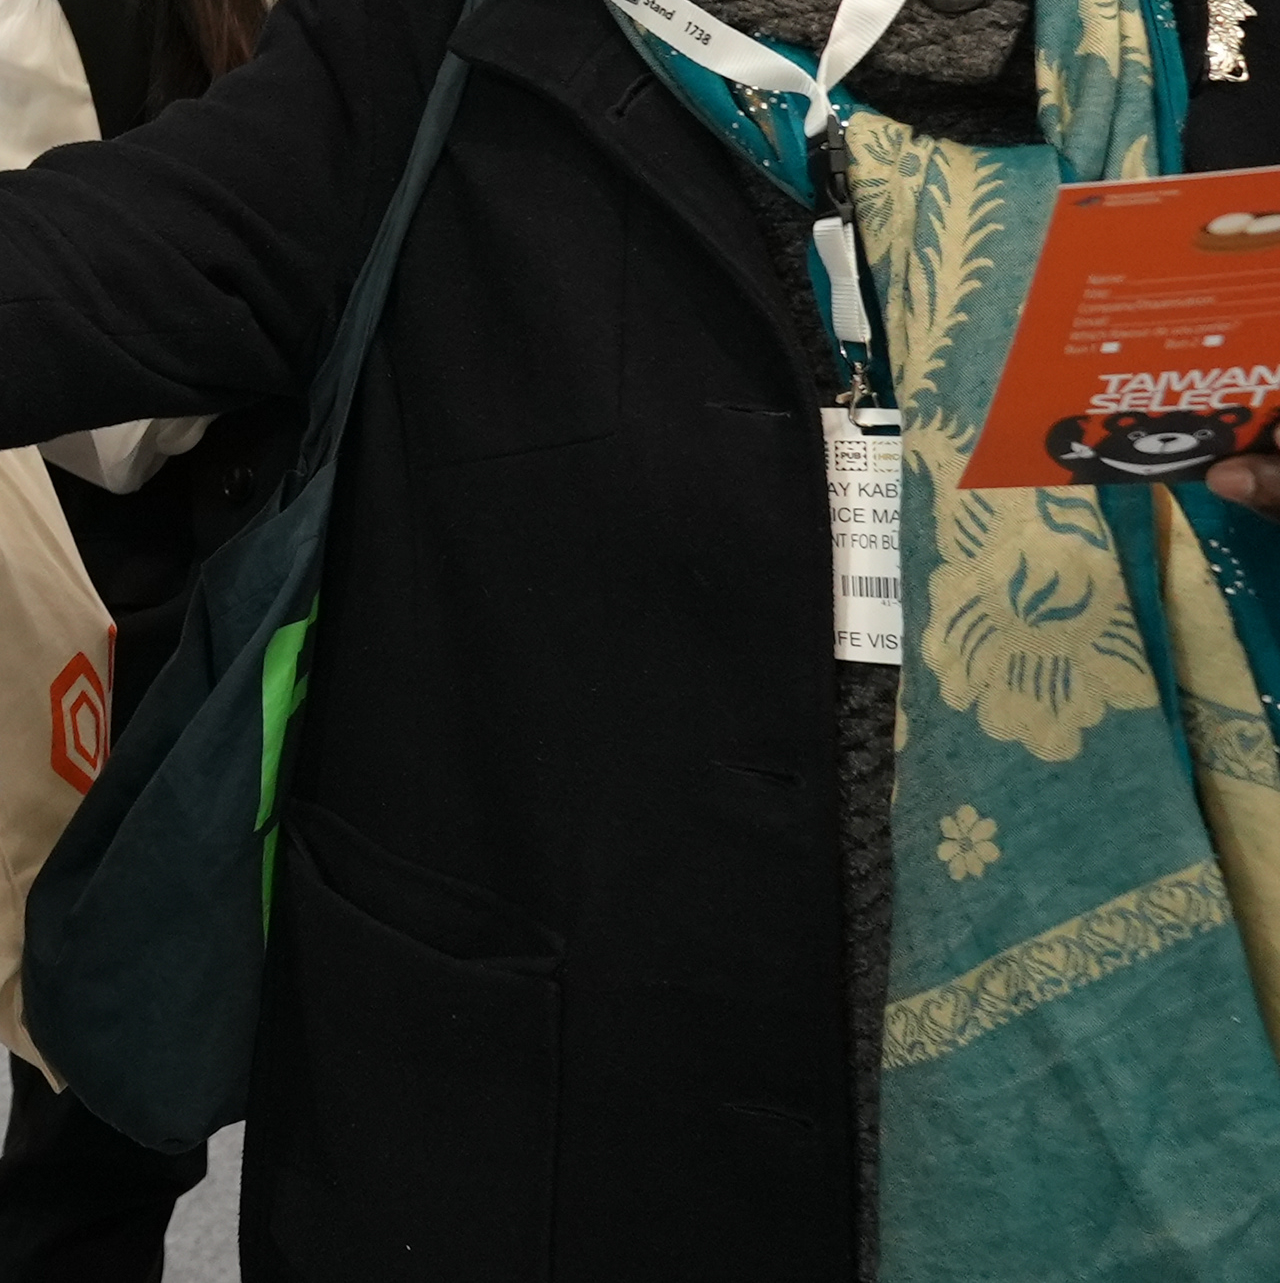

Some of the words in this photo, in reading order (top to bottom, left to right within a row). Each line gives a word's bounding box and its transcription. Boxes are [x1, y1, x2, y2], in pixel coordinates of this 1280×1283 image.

[683, 21, 713, 46] 1738
[1098, 363, 1280, 394] TAIWAN
[1085, 386, 1269, 415] SELECT
[840, 451, 861, 460] PUB
[858, 482, 899, 498] KAB
[851, 533, 877, 550] FOR
[867, 633, 900, 650] VIS
